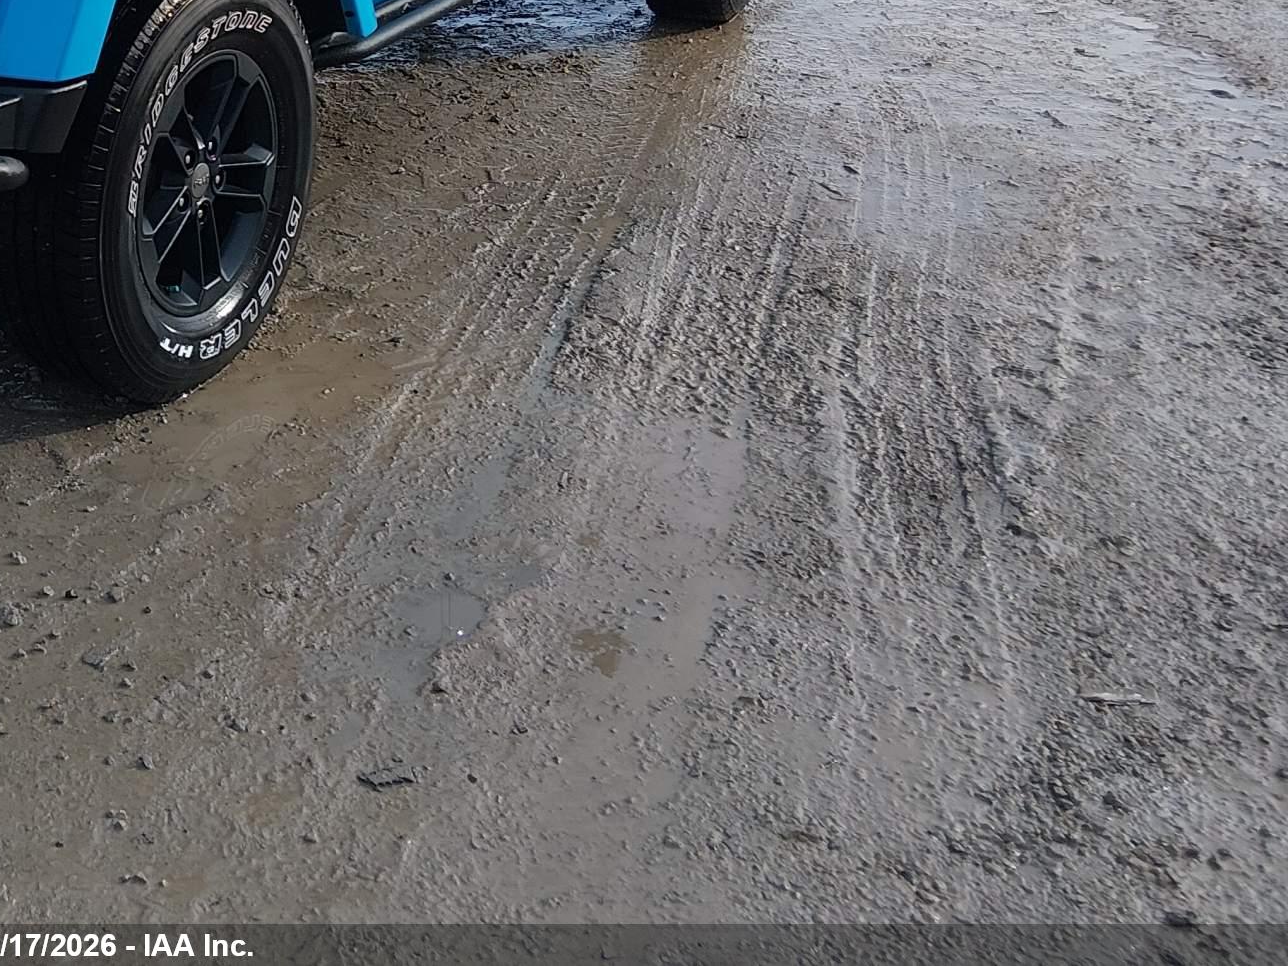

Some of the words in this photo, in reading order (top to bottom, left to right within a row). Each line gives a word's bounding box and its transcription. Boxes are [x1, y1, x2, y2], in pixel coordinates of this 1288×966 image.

[127, 9, 273, 218] BRIDGESTONE
[159, 337, 194, 359] H/T
[200, 196, 303, 359] DUELER
